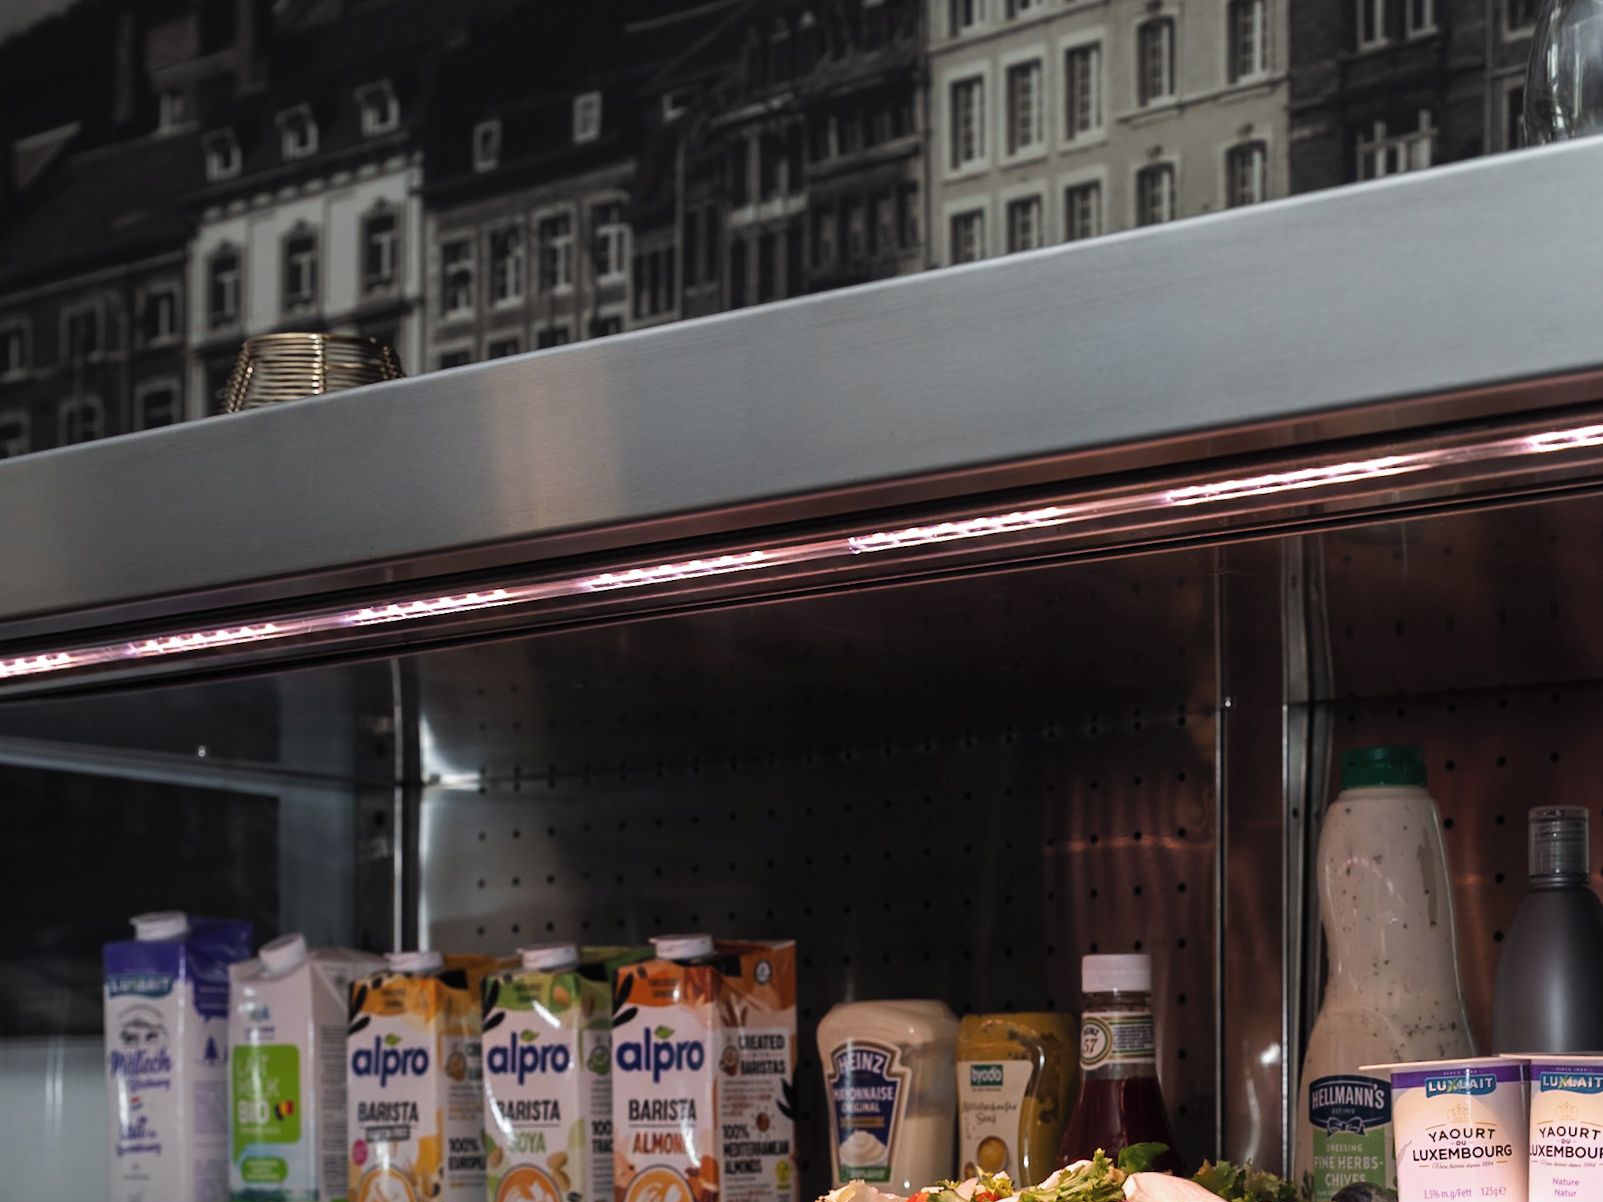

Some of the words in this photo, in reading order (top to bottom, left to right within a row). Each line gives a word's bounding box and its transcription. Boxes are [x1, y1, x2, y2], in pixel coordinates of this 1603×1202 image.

[352, 1035, 429, 1087] alpro
[487, 1031, 570, 1086] alpro
[616, 1027, 705, 1084] alpro
[838, 1051, 885, 1074] HEINZ
[1428, 1077, 1494, 1093] LUXLAIT
[1311, 1084, 1386, 1110] HELLMANN'S
[358, 1101, 419, 1122] BARISTA
[628, 1099, 697, 1121] BARISTA
[632, 1131, 692, 1155] ALMON
[1428, 1127, 1496, 1143] YAOURT
[1539, 1126, 1601, 1141] YAOURT
[1412, 1144, 1513, 1162] LUXEMBOURG
[1529, 1145, 1603, 1159] UXEMBOU
[1314, 1156, 1337, 1169] FINE
[1552, 1178, 1580, 1186] Nature
[1554, 1188, 1577, 1198] Natur
